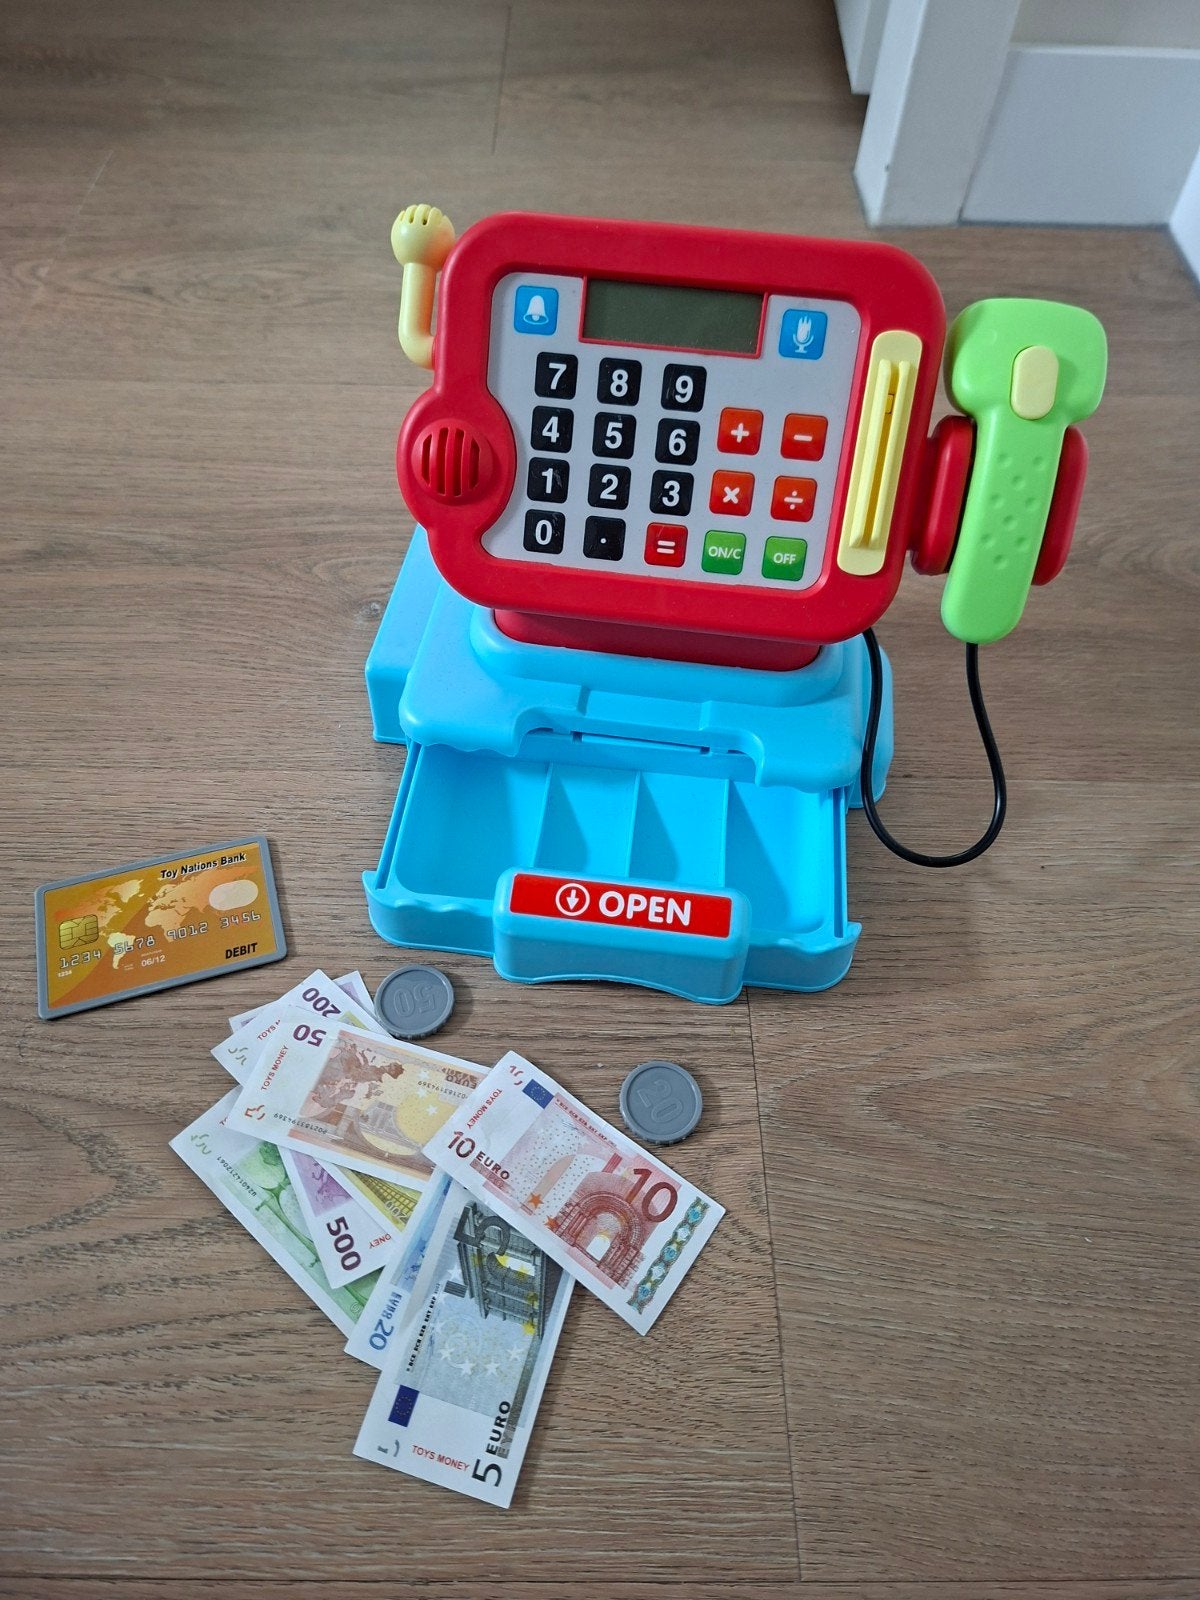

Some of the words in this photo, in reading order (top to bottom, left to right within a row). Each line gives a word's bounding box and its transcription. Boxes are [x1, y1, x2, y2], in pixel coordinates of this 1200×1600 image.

[548, 362, 567, 390] 7
[609, 368, 629, 397] 8
[674, 375, 694, 403] 9
[541, 416, 560, 443] 4
[605, 422, 623, 449] 5
[668, 429, 687, 456] 6
[541, 468, 554, 494] 1
[600, 474, 619, 500] 2
[662, 480, 680, 507] 3
[535, 520, 552, 546] 0
[708, 546, 741, 559] ON/C
[773, 552, 796, 565] OFF
[160, 869, 178, 879] Toy
[180, 860, 218, 875] Nations
[220, 852, 247, 866] Bank
[598, 890, 691, 926] OPEN
[60, 950, 101, 969] 1234
[114, 935, 155, 955] 5678
[167, 922, 208, 940] 9012
[220, 911, 261, 928] 3456
[225, 942, 258, 959] DEBIT
[141, 954, 166, 967] 06/12
[302, 987, 341, 1018] 200
[257, 1024, 276, 1041] TOYS
[292, 1024, 327, 1047] 50
[261, 1072, 275, 1090] TOYS
[272, 1044, 289, 1071] MONEY
[446, 1075, 477, 1089] EURO
[486, 1088, 502, 1105] TOYS
[467, 1105, 487, 1129] MONEY
[448, 1131, 475, 1158] 10
[476, 1150, 509, 1180] EURO
[625, 1169, 678, 1222] 10
[326, 1216, 361, 1271] 500
[369, 1233, 392, 1249] ONEY
[369, 1318, 394, 1351] 20
[485, 1401, 510, 1455] EURO
[411, 1445, 435, 1460] TOYS
[437, 1454, 470, 1472] MONEY
[471, 1458, 503, 1487] 5
